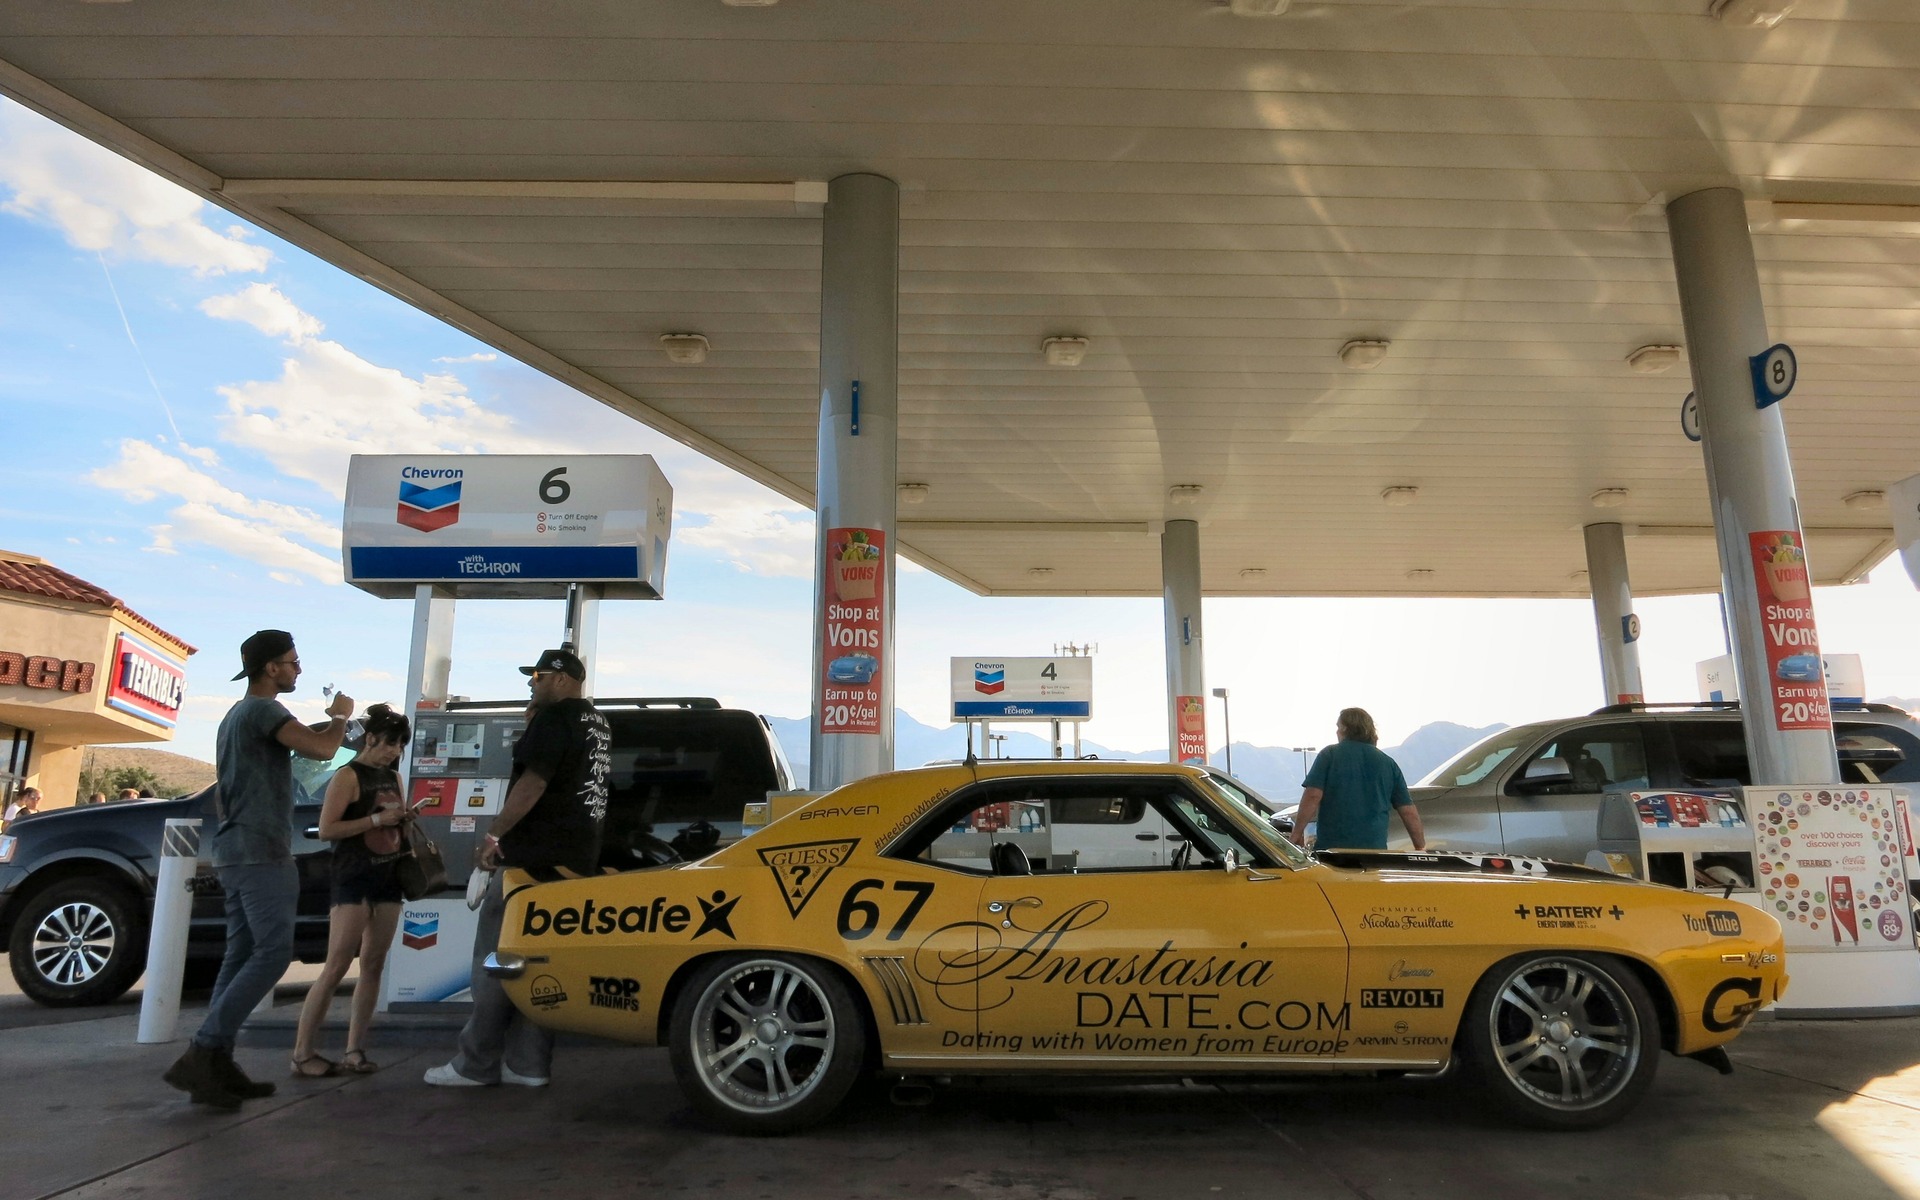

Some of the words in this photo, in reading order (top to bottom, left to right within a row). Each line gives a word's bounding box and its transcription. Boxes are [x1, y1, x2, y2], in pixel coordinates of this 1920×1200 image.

[1773, 359, 1786, 384] 8
[401, 466, 464, 480] Chevron
[538, 466, 571, 505] 6
[576, 513, 599, 521] Engine
[558, 525, 587, 533] Smoking
[457, 561, 521, 576] TECHRON
[841, 567, 874, 582] VONS
[1775, 567, 1806, 582] VONS
[828, 604, 862, 622] Shop
[866, 605, 880, 621] at
[1766, 604, 1803, 622] Shop
[828, 622, 879, 648] Vons
[1629, 620, 1638, 634] 2
[1768, 622, 1819, 647] Vons
[1041, 662, 1057, 681] 4
[121, 652, 188, 713] TERRIBLE'S
[825, 688, 848, 700] Earn
[851, 691, 864, 703] up
[867, 688, 878, 701] to
[1777, 686, 1804, 698] Earn
[1806, 688, 1818, 700] up
[1003, 708, 1034, 716] TECHRON
[1180, 733, 1198, 742] Shop
[1180, 742, 1205, 755] Vons
[799, 804, 880, 821] BRAVEN
[873, 786, 950, 850] #HeelsOnWheels
[1806, 840, 1840, 848] discover
[1840, 841, 1861, 849] yours
[404, 910, 440, 919] Chevron
[522, 896, 691, 936] betsafe
[836, 878, 935, 941] 67
[1534, 905, 1603, 919] BATTERY
[1360, 913, 1401, 930] Nicolas
[1401, 915, 1455, 930] Feuillatte
[1537, 920, 1558, 929] ENERGY
[1559, 920, 1577, 929] DRINK
[1681, 913, 1740, 933] YouTube
[913, 896, 1274, 1012] Anastasia
[588, 975, 640, 998] TOP
[588, 991, 640, 1013] TRUMPS
[1362, 990, 1443, 1007] REVOLT
[1075, 991, 1352, 1031] DATE.COM
[941, 1029, 1023, 1053] Dating
[1031, 1031, 1085, 1051] with
[1093, 1033, 1188, 1052] Women
[1190, 1032, 1258, 1057] from
[1262, 1034, 1349, 1057] Europe
[1352, 1036, 1399, 1046] ARMIN
[1399, 1036, 1449, 1046] STROM
